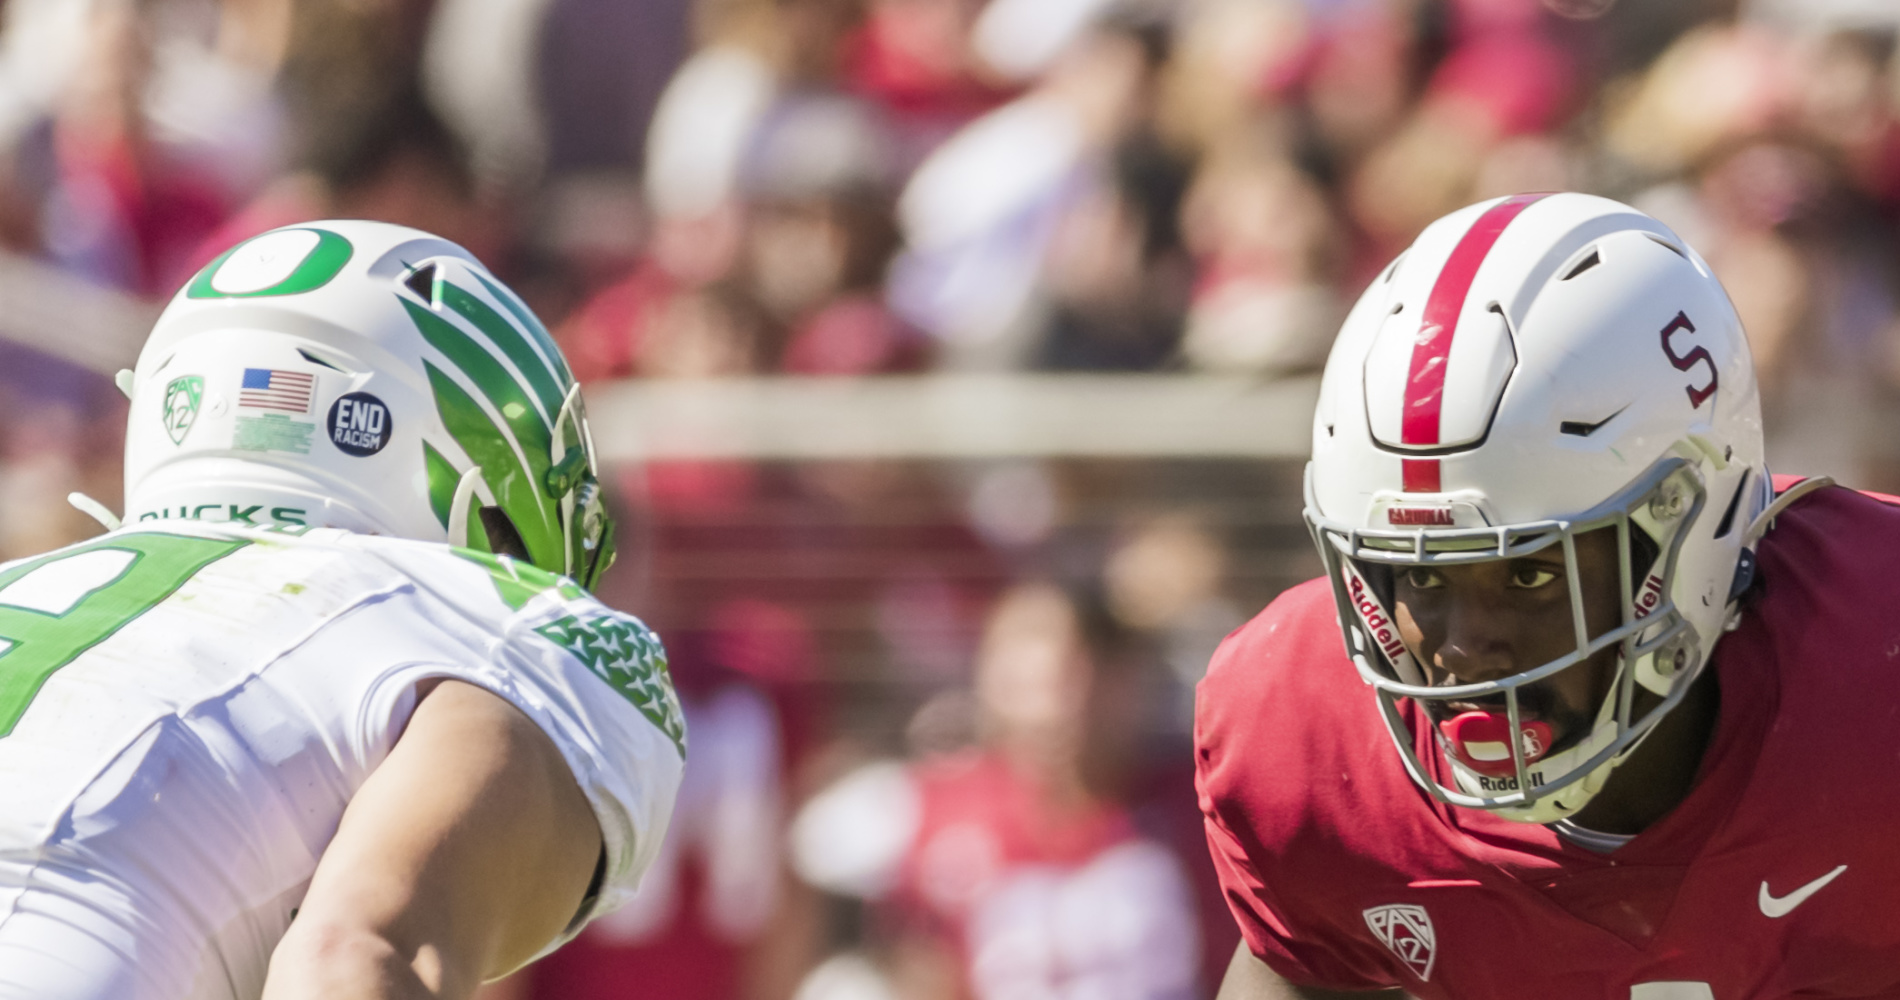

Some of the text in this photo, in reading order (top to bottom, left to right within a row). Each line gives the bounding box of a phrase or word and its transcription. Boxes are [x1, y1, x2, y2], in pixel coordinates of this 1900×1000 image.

[1660, 310, 1719, 409] S
[168, 405, 190, 431] 12
[335, 398, 385, 433] END
[333, 427, 381, 450] RACISM
[1479, 771, 1545, 791] Riddll
[1368, 908, 1431, 950] PAC
[1394, 937, 1427, 964] 12
